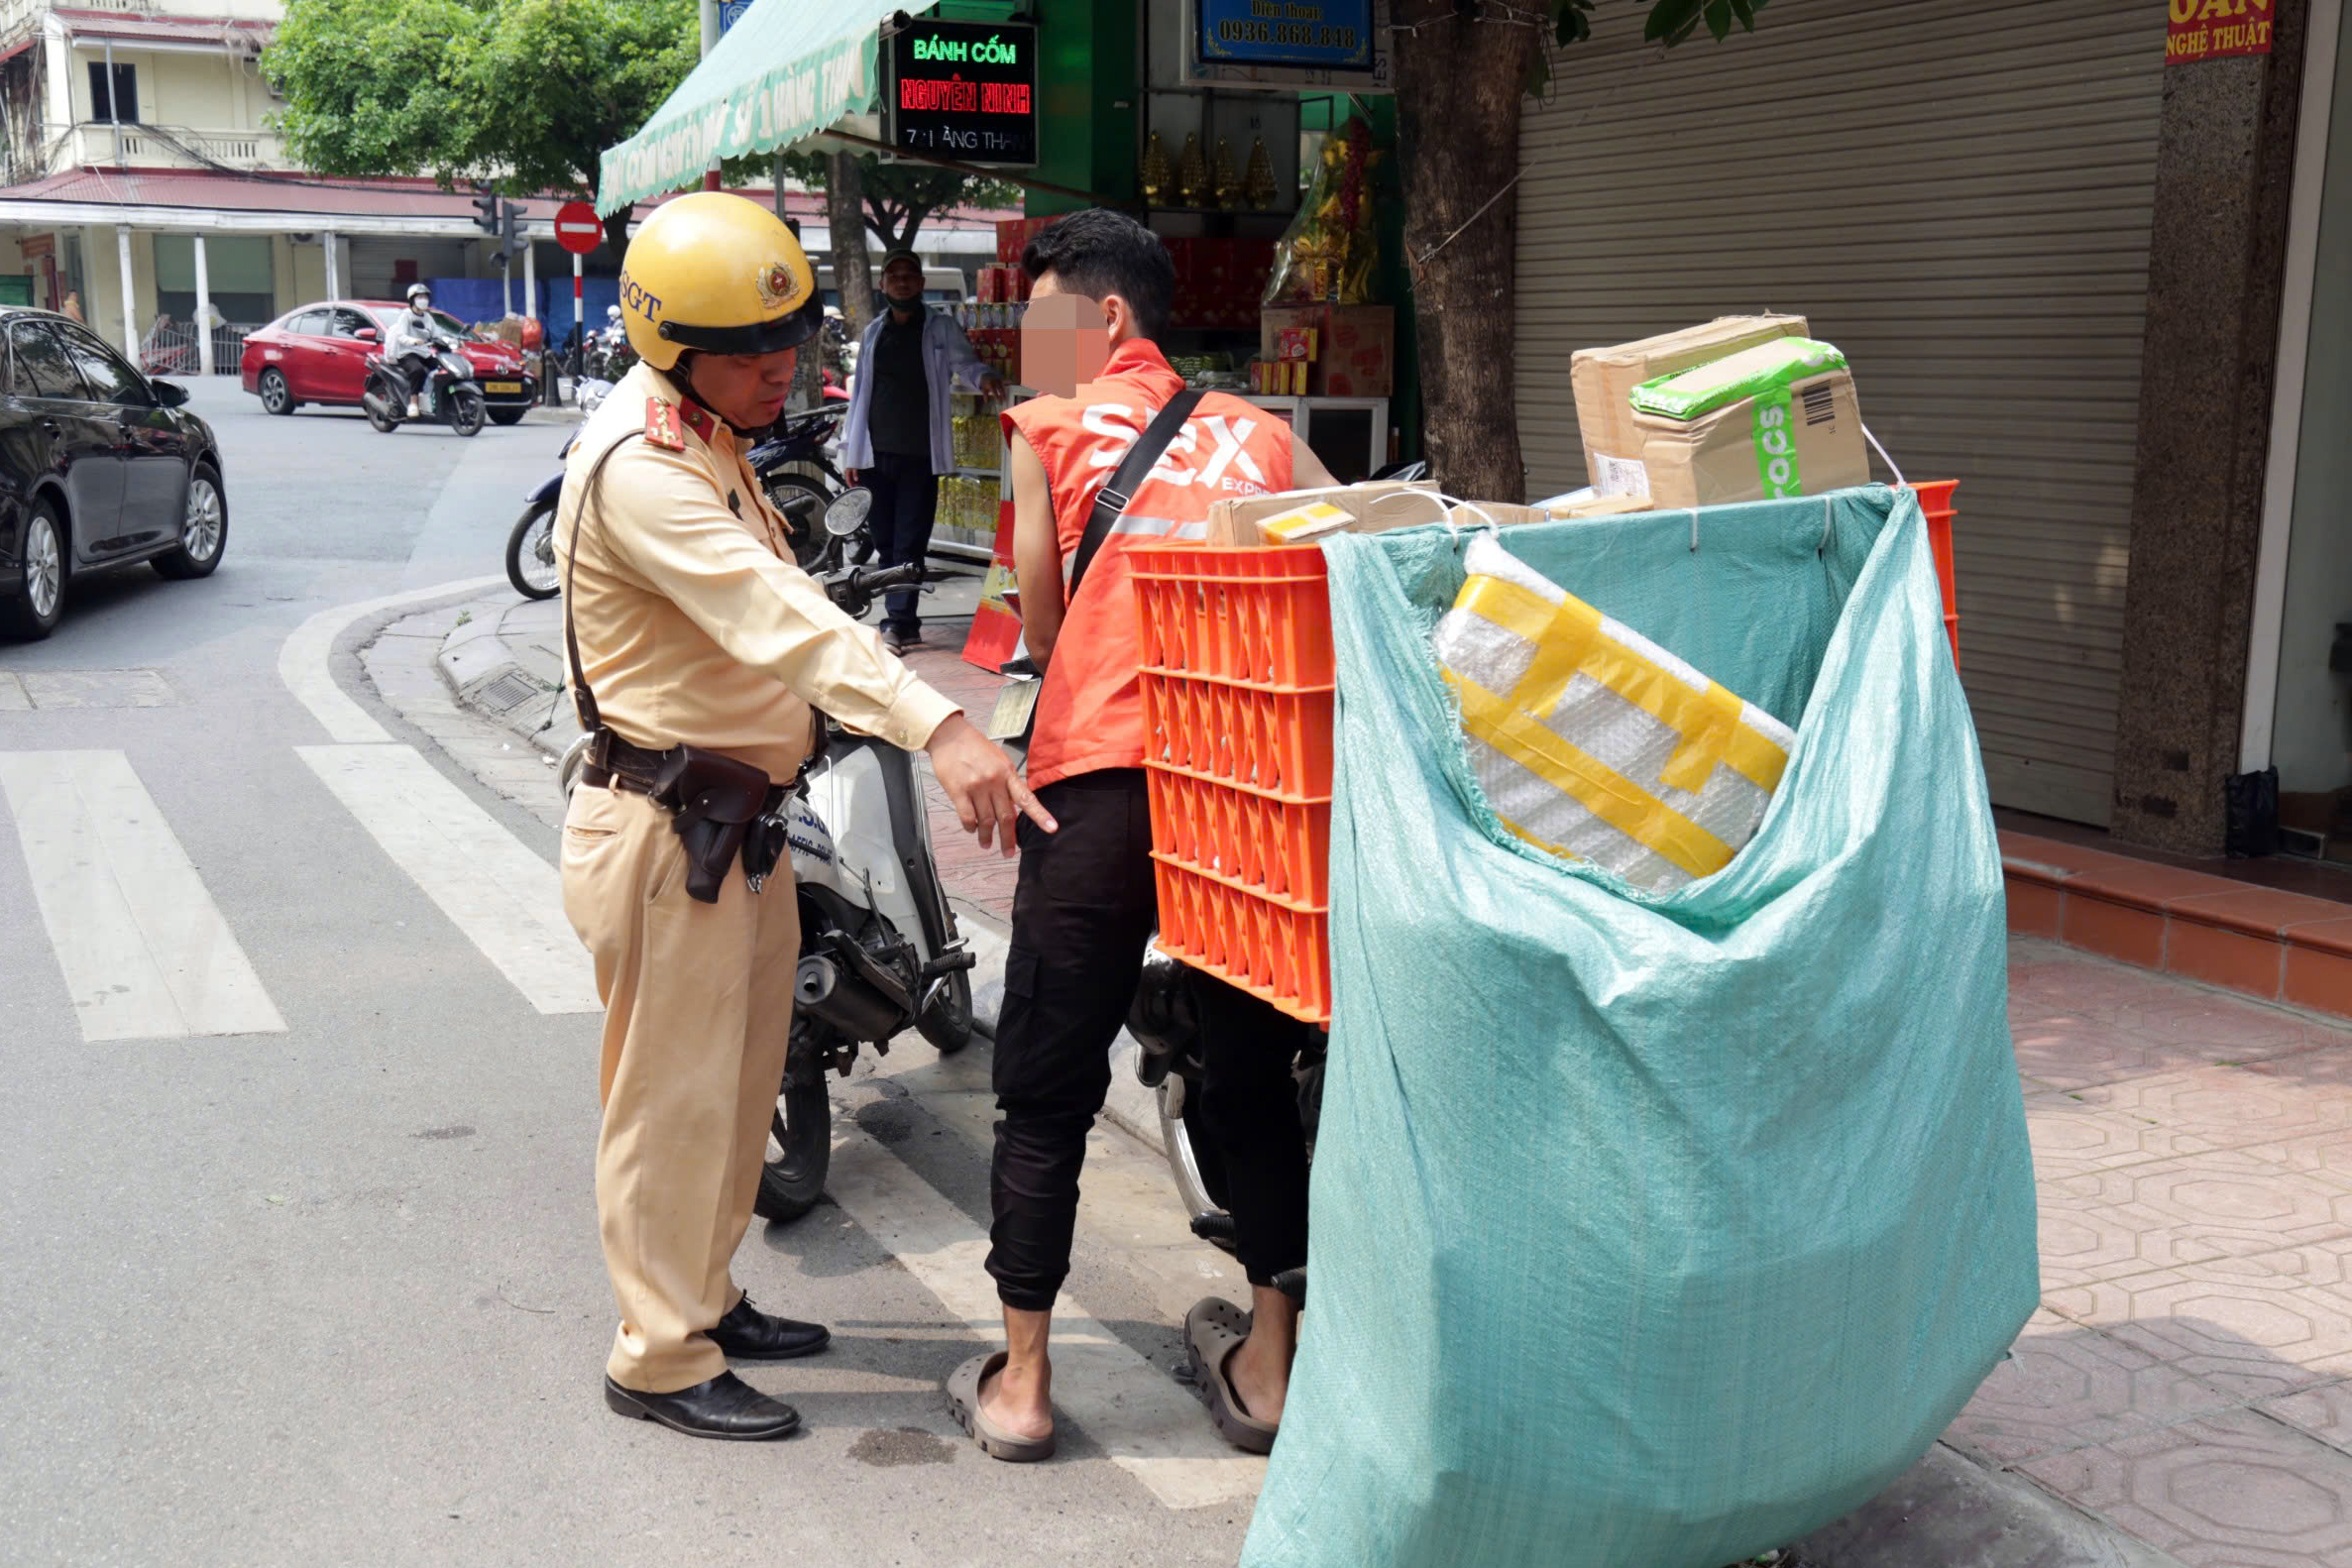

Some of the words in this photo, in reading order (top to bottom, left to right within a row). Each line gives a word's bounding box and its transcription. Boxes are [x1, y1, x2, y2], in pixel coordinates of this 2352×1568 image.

[914, 34, 967, 61] BÁNH
[971, 35, 1016, 63] CỐM
[2166, 24, 2208, 57] NGHỆ
[2213, 16, 2271, 52] THUẬT
[901, 72, 977, 111] NGUYÊN
[981, 82, 1031, 114] NINH
